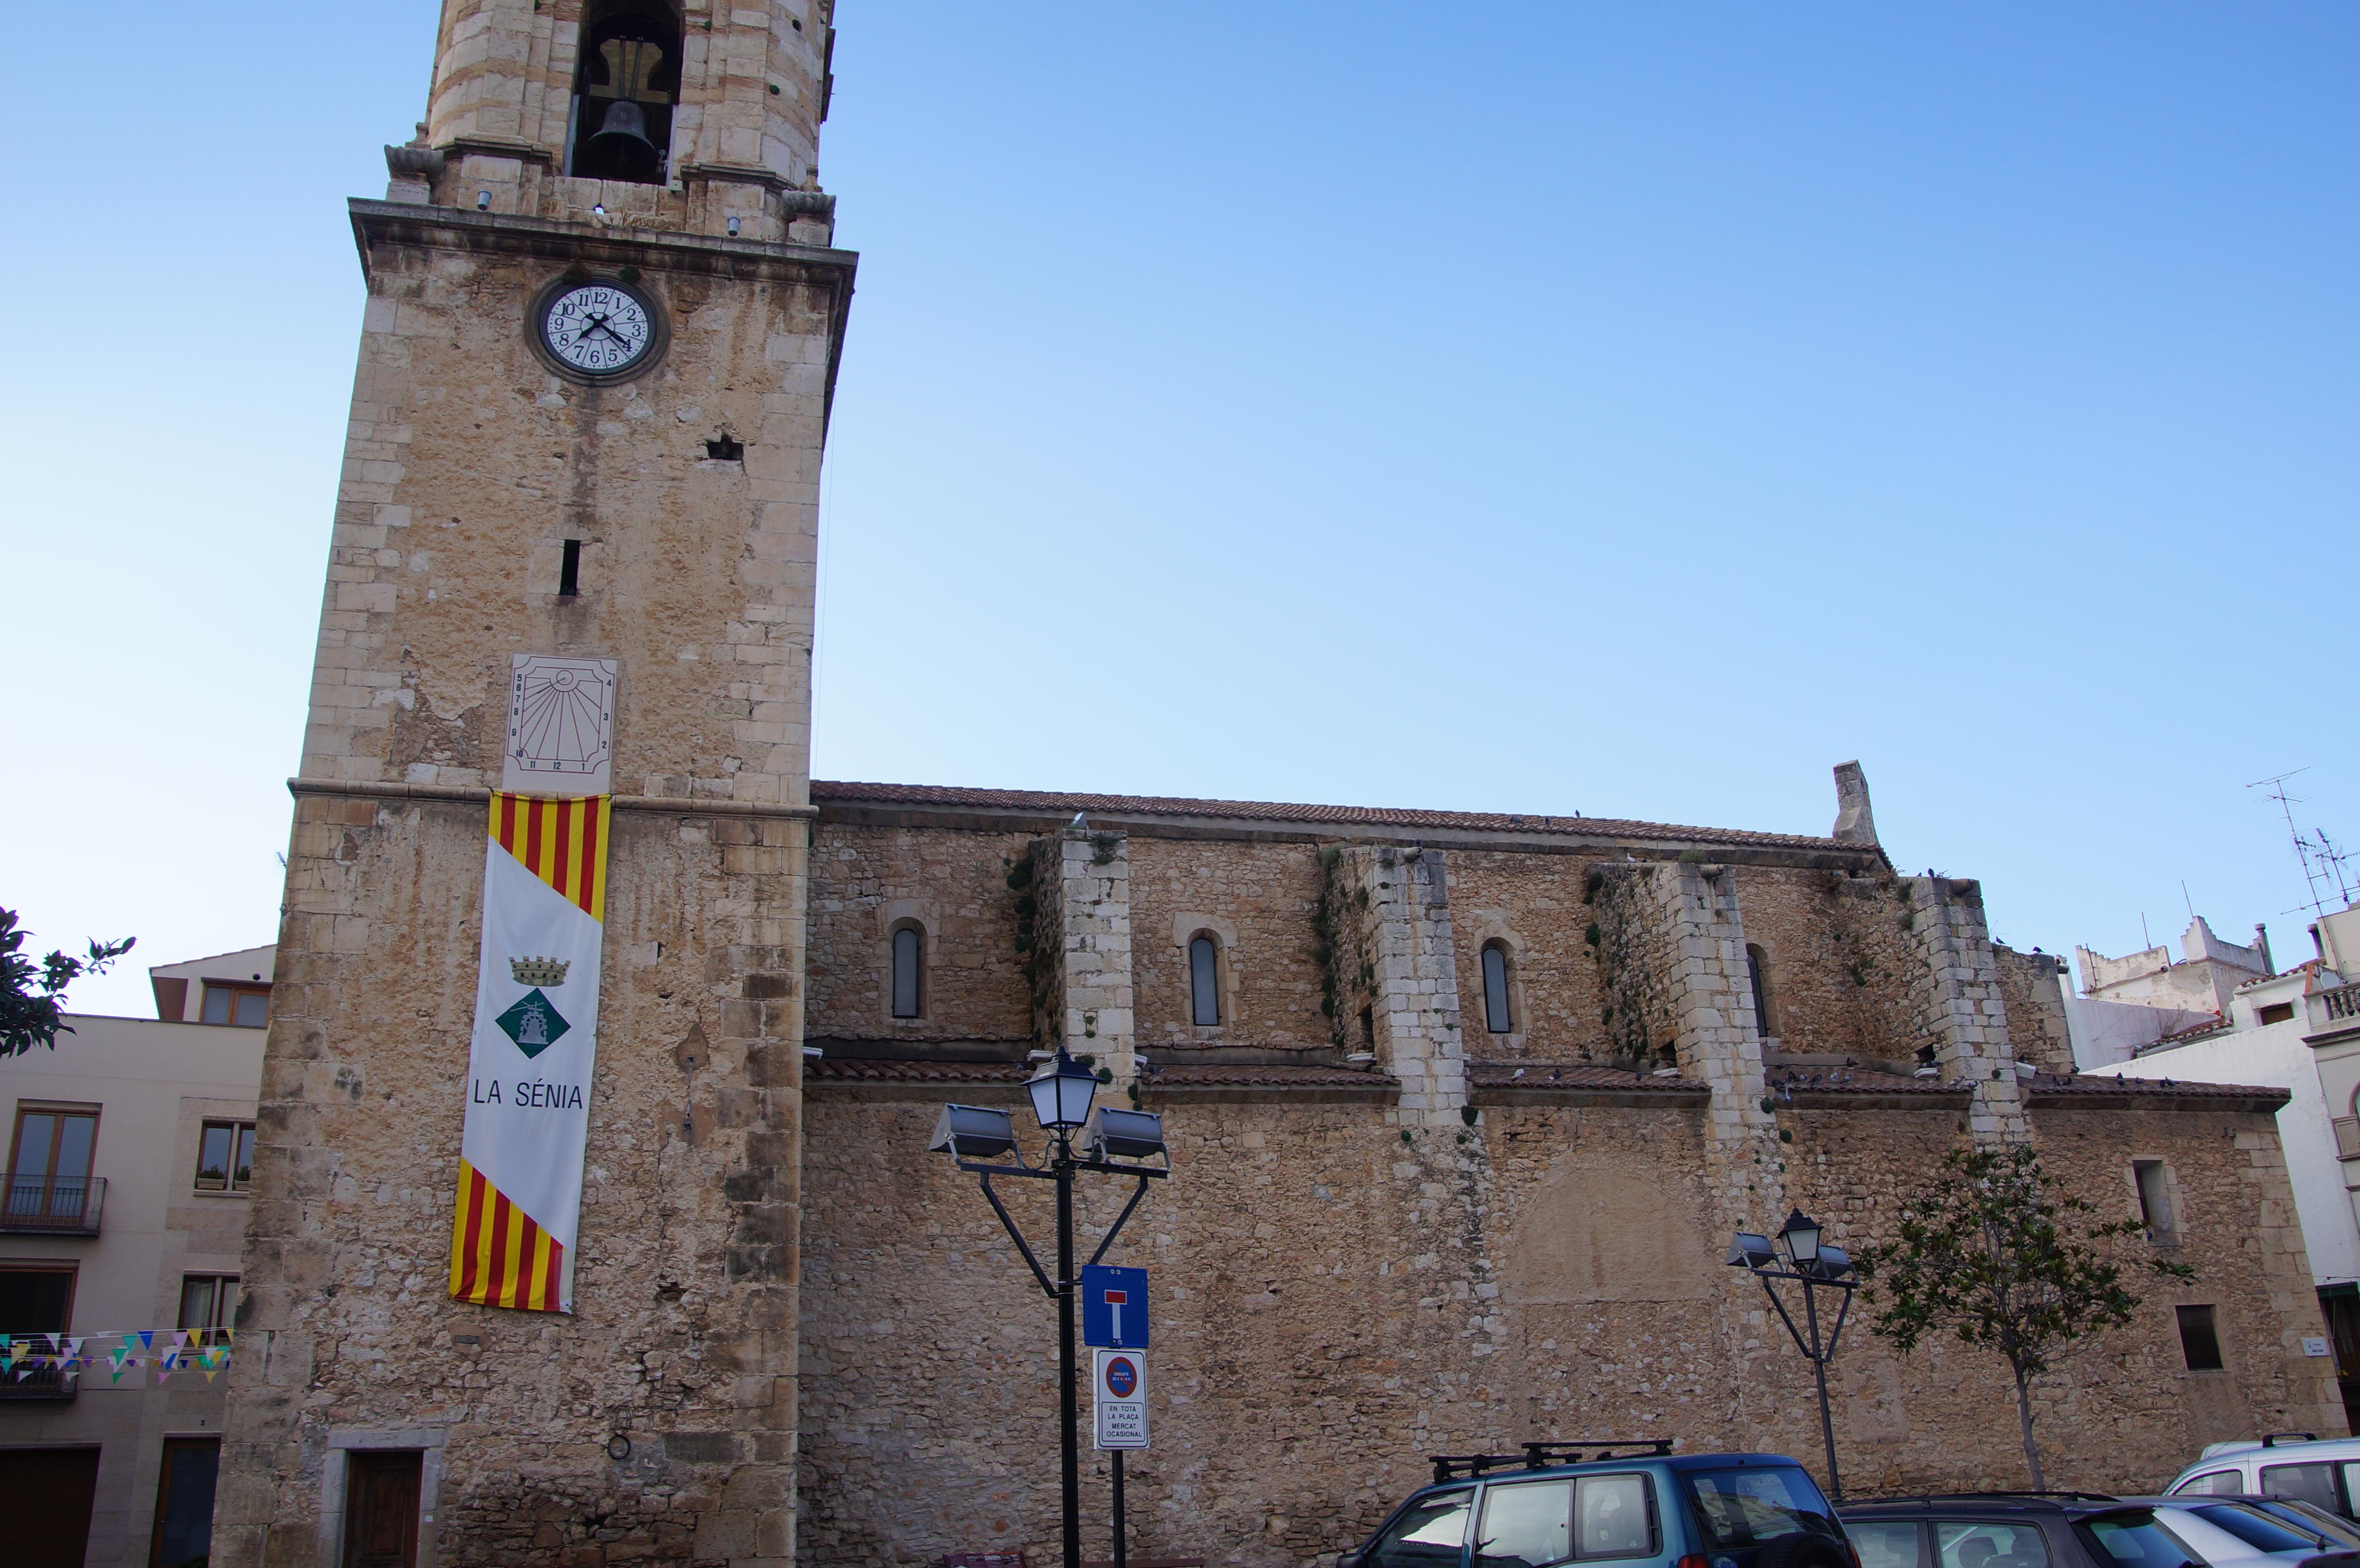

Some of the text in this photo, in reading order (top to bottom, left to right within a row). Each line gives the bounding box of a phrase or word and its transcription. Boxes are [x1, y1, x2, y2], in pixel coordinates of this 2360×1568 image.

[578, 294, 589, 306] 11
[593, 292, 608, 304] 12
[615, 297, 620, 309] 1
[561, 303, 575, 316] 10
[627, 308, 636, 320] 2
[554, 318, 564, 330] 9
[632, 324, 641, 337] 3
[559, 333, 569, 346] 8
[623, 339, 632, 352] 4
[574, 345, 584, 359] 7
[590, 350, 600, 364] 6
[608, 349, 617, 361] 5
[516, 749, 523, 758] 10
[474, 1078, 583, 1109] LA SÉNIA
